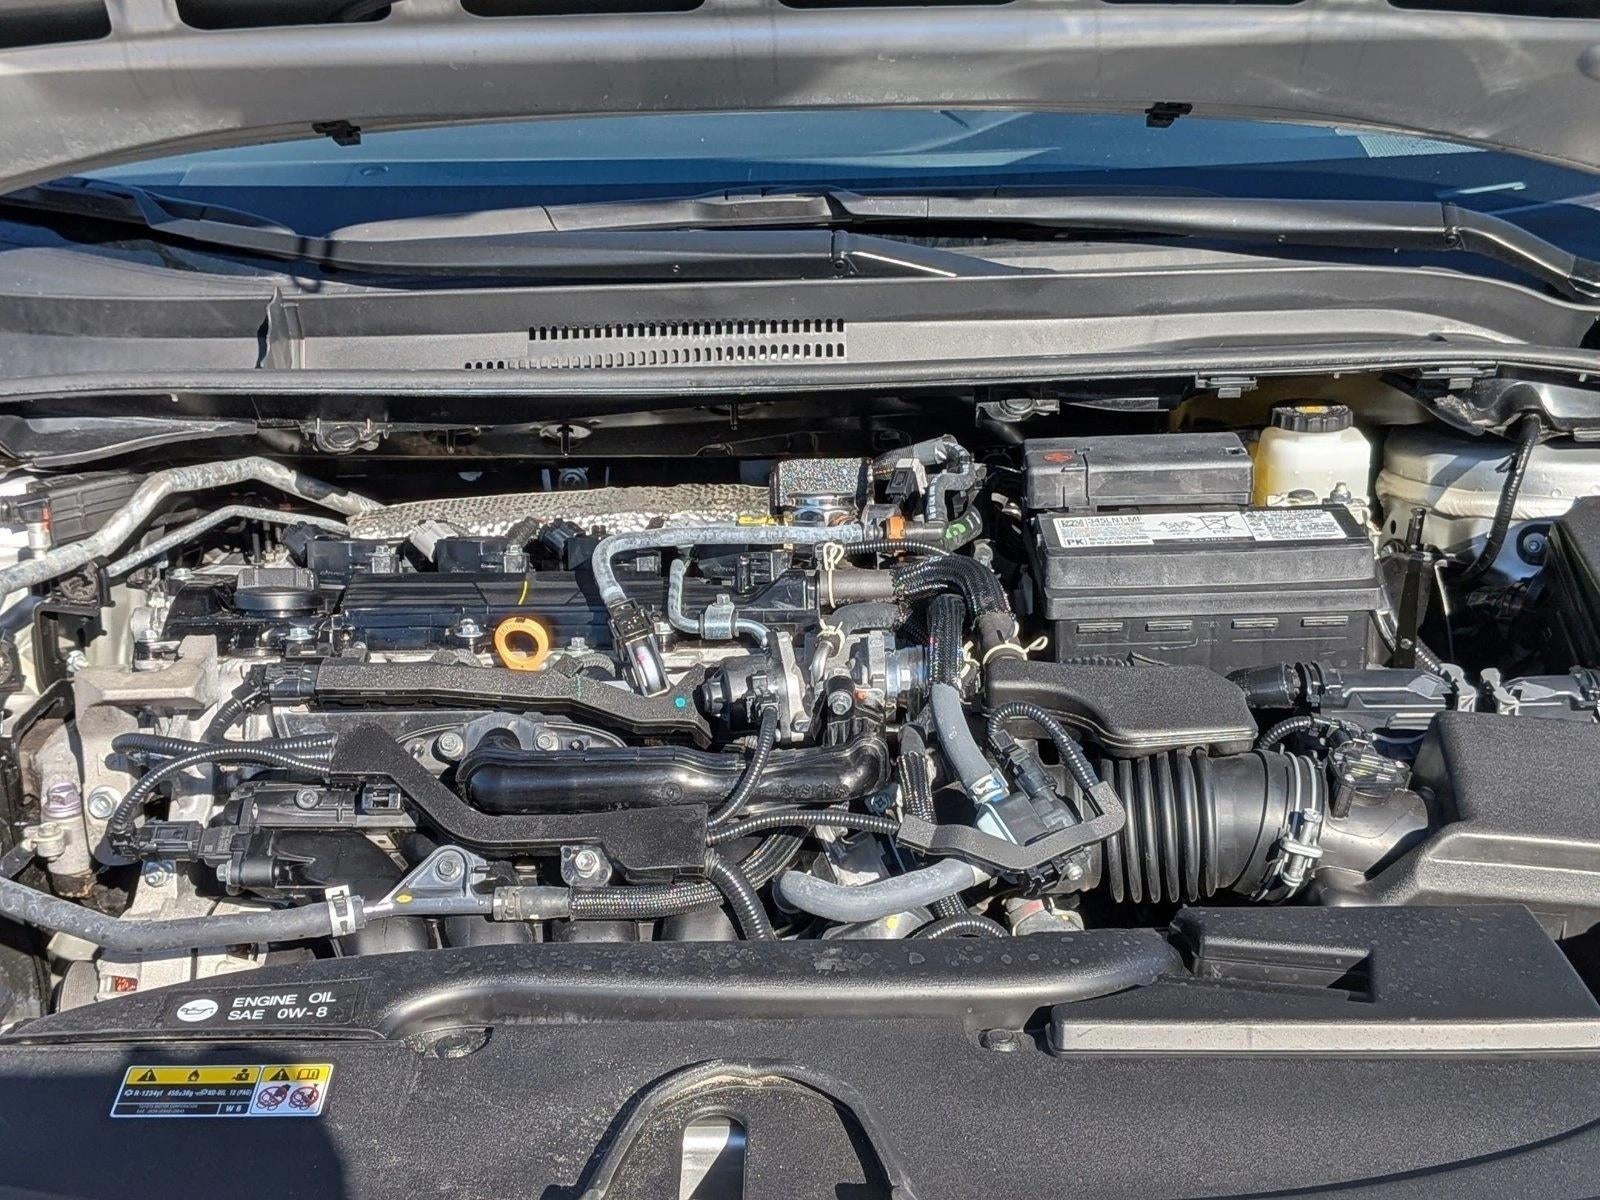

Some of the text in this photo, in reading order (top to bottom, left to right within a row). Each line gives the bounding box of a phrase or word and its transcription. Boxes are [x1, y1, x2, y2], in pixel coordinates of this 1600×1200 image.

[1066, 538, 1084, 546] PK
[232, 991, 337, 1008] ENGINE OIL
[227, 1006, 328, 1021] SAE 0W-8
